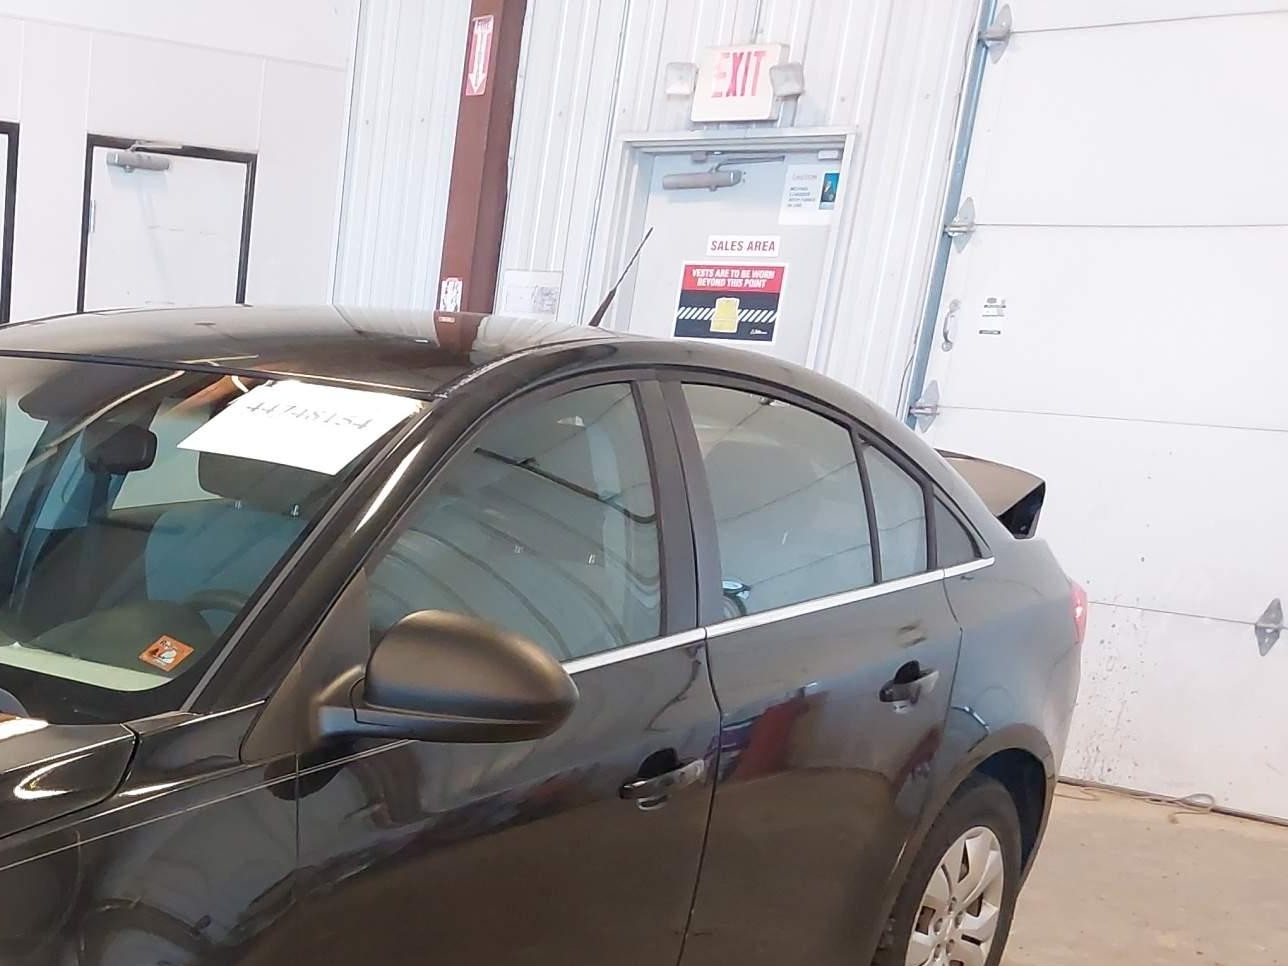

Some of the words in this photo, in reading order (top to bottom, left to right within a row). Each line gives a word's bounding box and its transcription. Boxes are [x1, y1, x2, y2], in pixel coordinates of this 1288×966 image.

[711, 51, 768, 97] EXIT
[711, 240, 744, 252] SALES
[747, 241, 775, 252] AREA
[692, 269, 714, 278] VESTS
[715, 269, 730, 278] ARE
[730, 270, 740, 278] TO
[740, 270, 751, 279] BE
[752, 270, 776, 279] WORN
[697, 278, 726, 287] BEYOND
[727, 279, 744, 288] THIS
[744, 279, 768, 289] POINT
